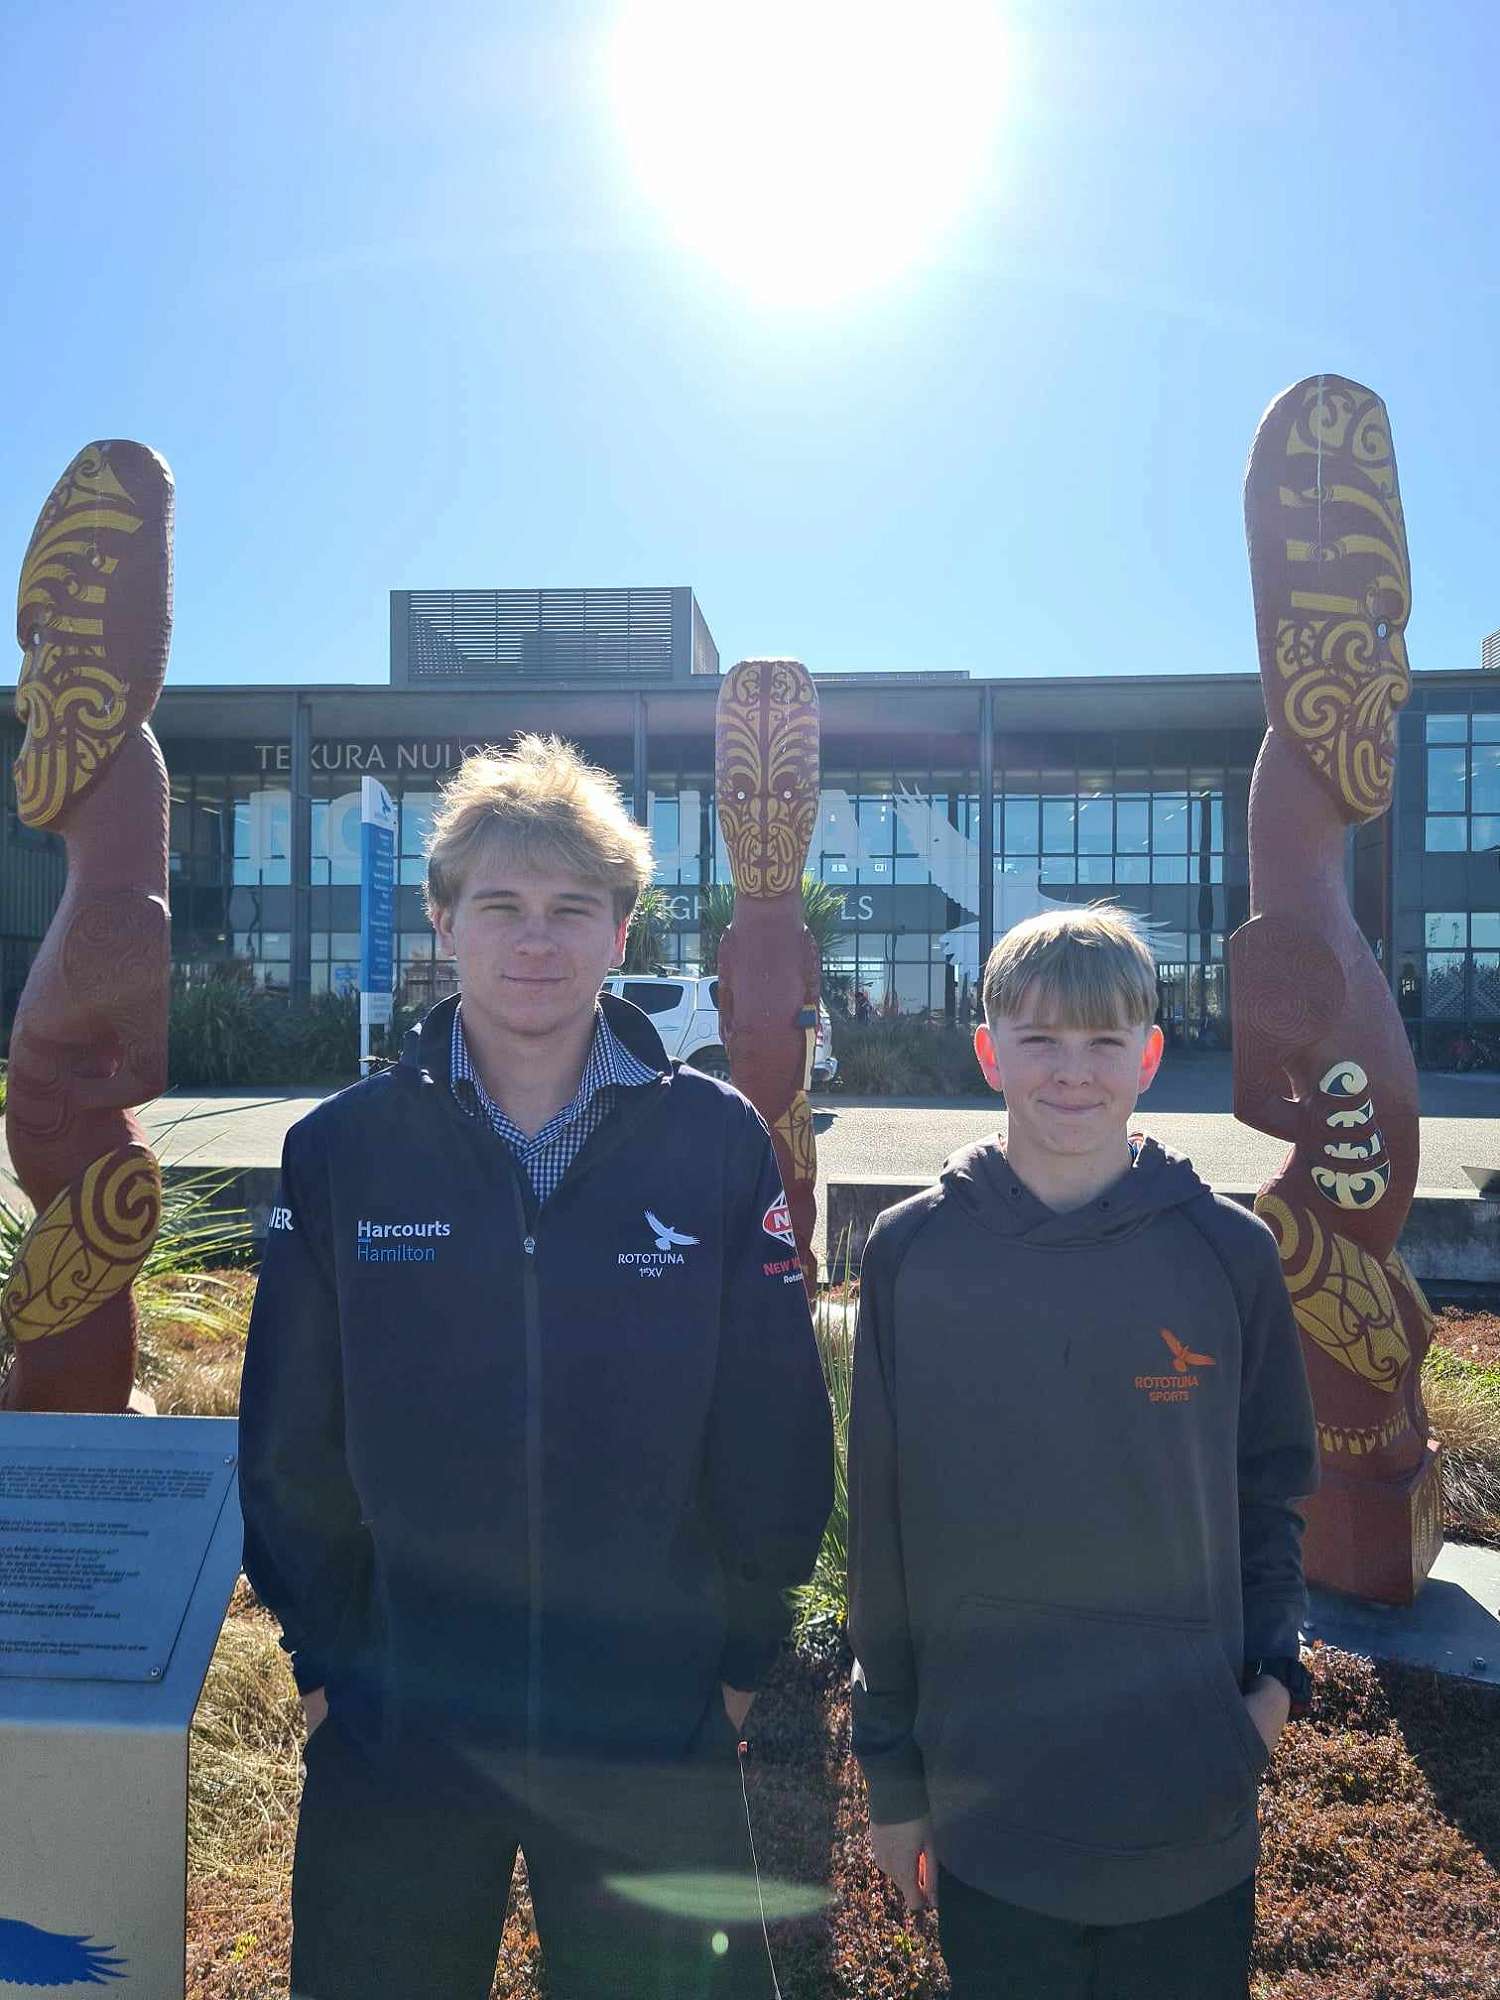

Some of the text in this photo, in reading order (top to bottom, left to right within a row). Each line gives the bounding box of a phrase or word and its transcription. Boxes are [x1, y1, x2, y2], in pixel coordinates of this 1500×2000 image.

[254, 744, 291, 770] TE
[397, 743, 450, 769] NUI
[357, 1219, 451, 1238] Harcourts
[357, 1244, 435, 1262] Hamilton
[618, 1253, 685, 1265] ROTOTUNA
[1135, 1375, 1200, 1389] ROTOTUNA
[1149, 1390, 1190, 1402] SPORTS
